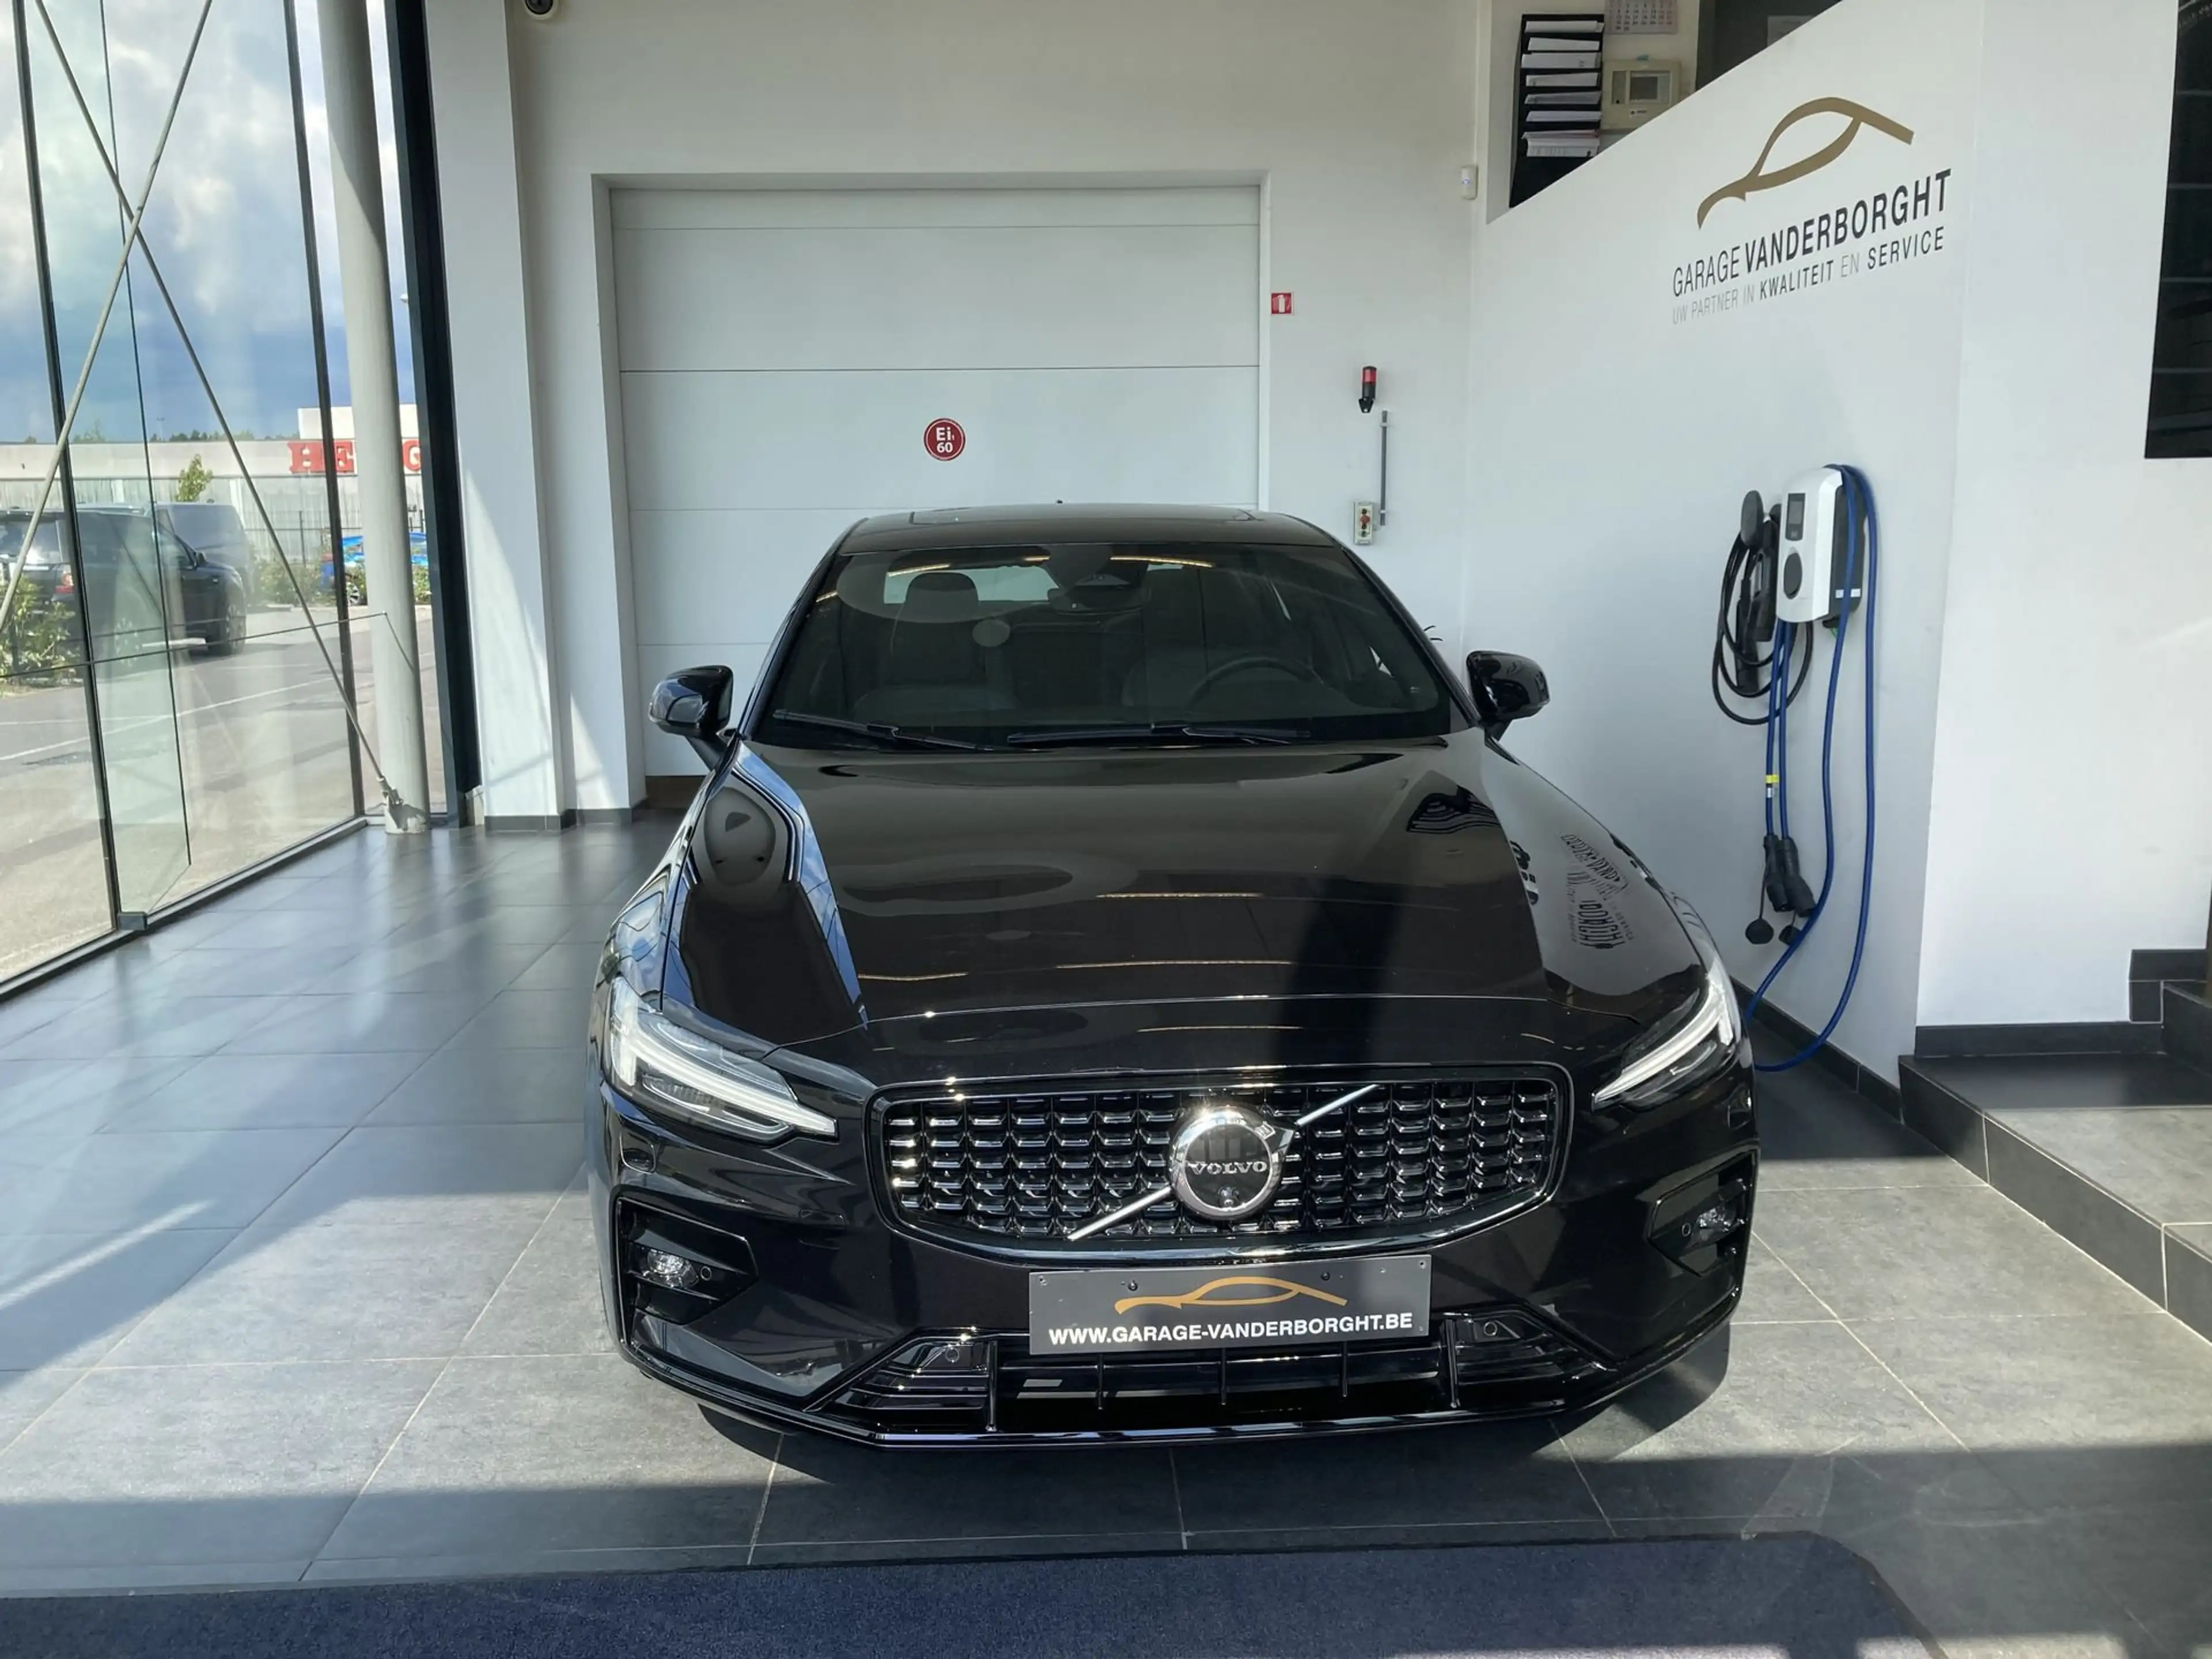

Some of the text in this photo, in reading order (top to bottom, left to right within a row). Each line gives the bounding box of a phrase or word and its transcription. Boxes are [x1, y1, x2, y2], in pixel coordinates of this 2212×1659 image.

[1673, 168, 1952, 297] GARAGE VANDERBORGHT
[1672, 226, 1945, 325] UW PARTNER IN KWALITEIT EN SERVICE
[937, 442, 953, 453] 60
[1187, 1160, 1268, 1176] VOLVO
[1048, 1312, 1413, 1346] WWW.GARAGE-VANDERBORGHT.BE
